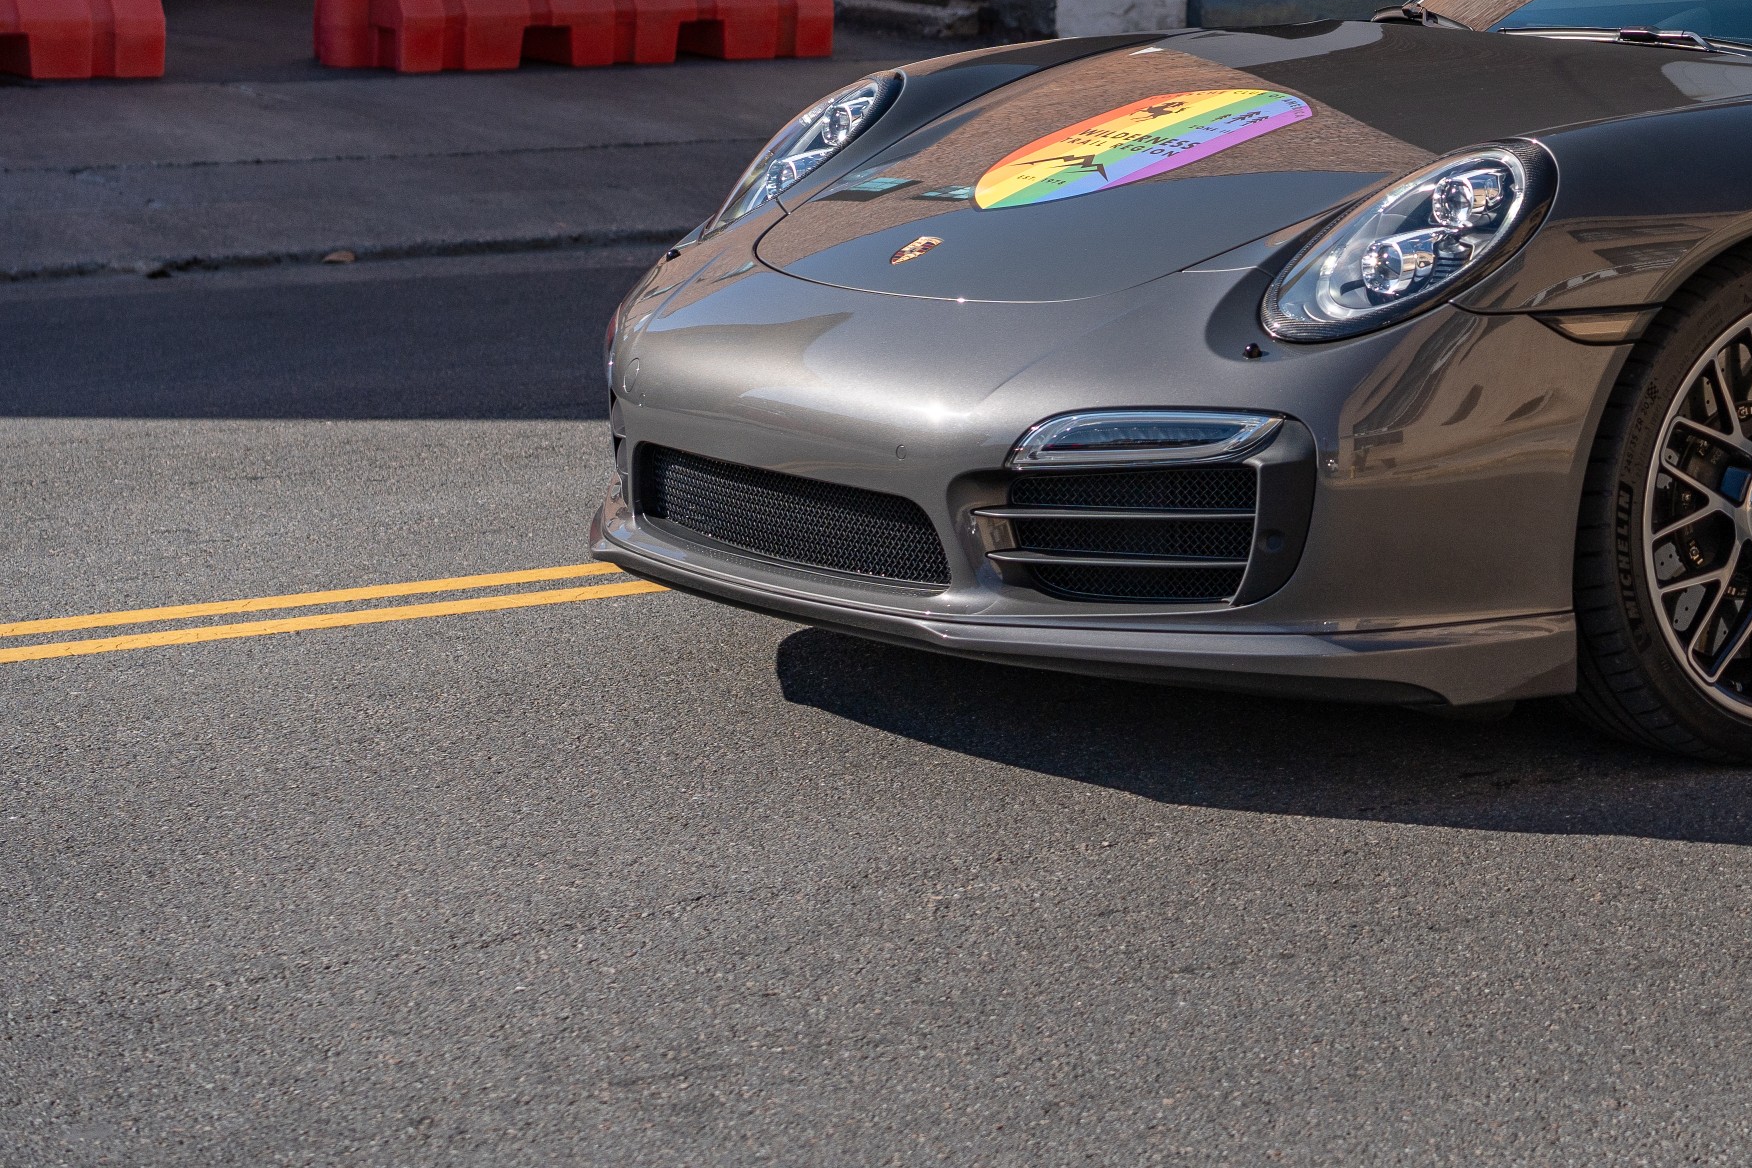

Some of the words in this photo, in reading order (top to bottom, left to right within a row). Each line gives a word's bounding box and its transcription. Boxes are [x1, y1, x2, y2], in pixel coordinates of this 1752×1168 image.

[1060, 137, 1108, 147] TRAIL
[1110, 143, 1181, 159] REGION
[1078, 128, 1201, 151] WILDERNESS
[1617, 489, 1641, 620] MICHELIN
